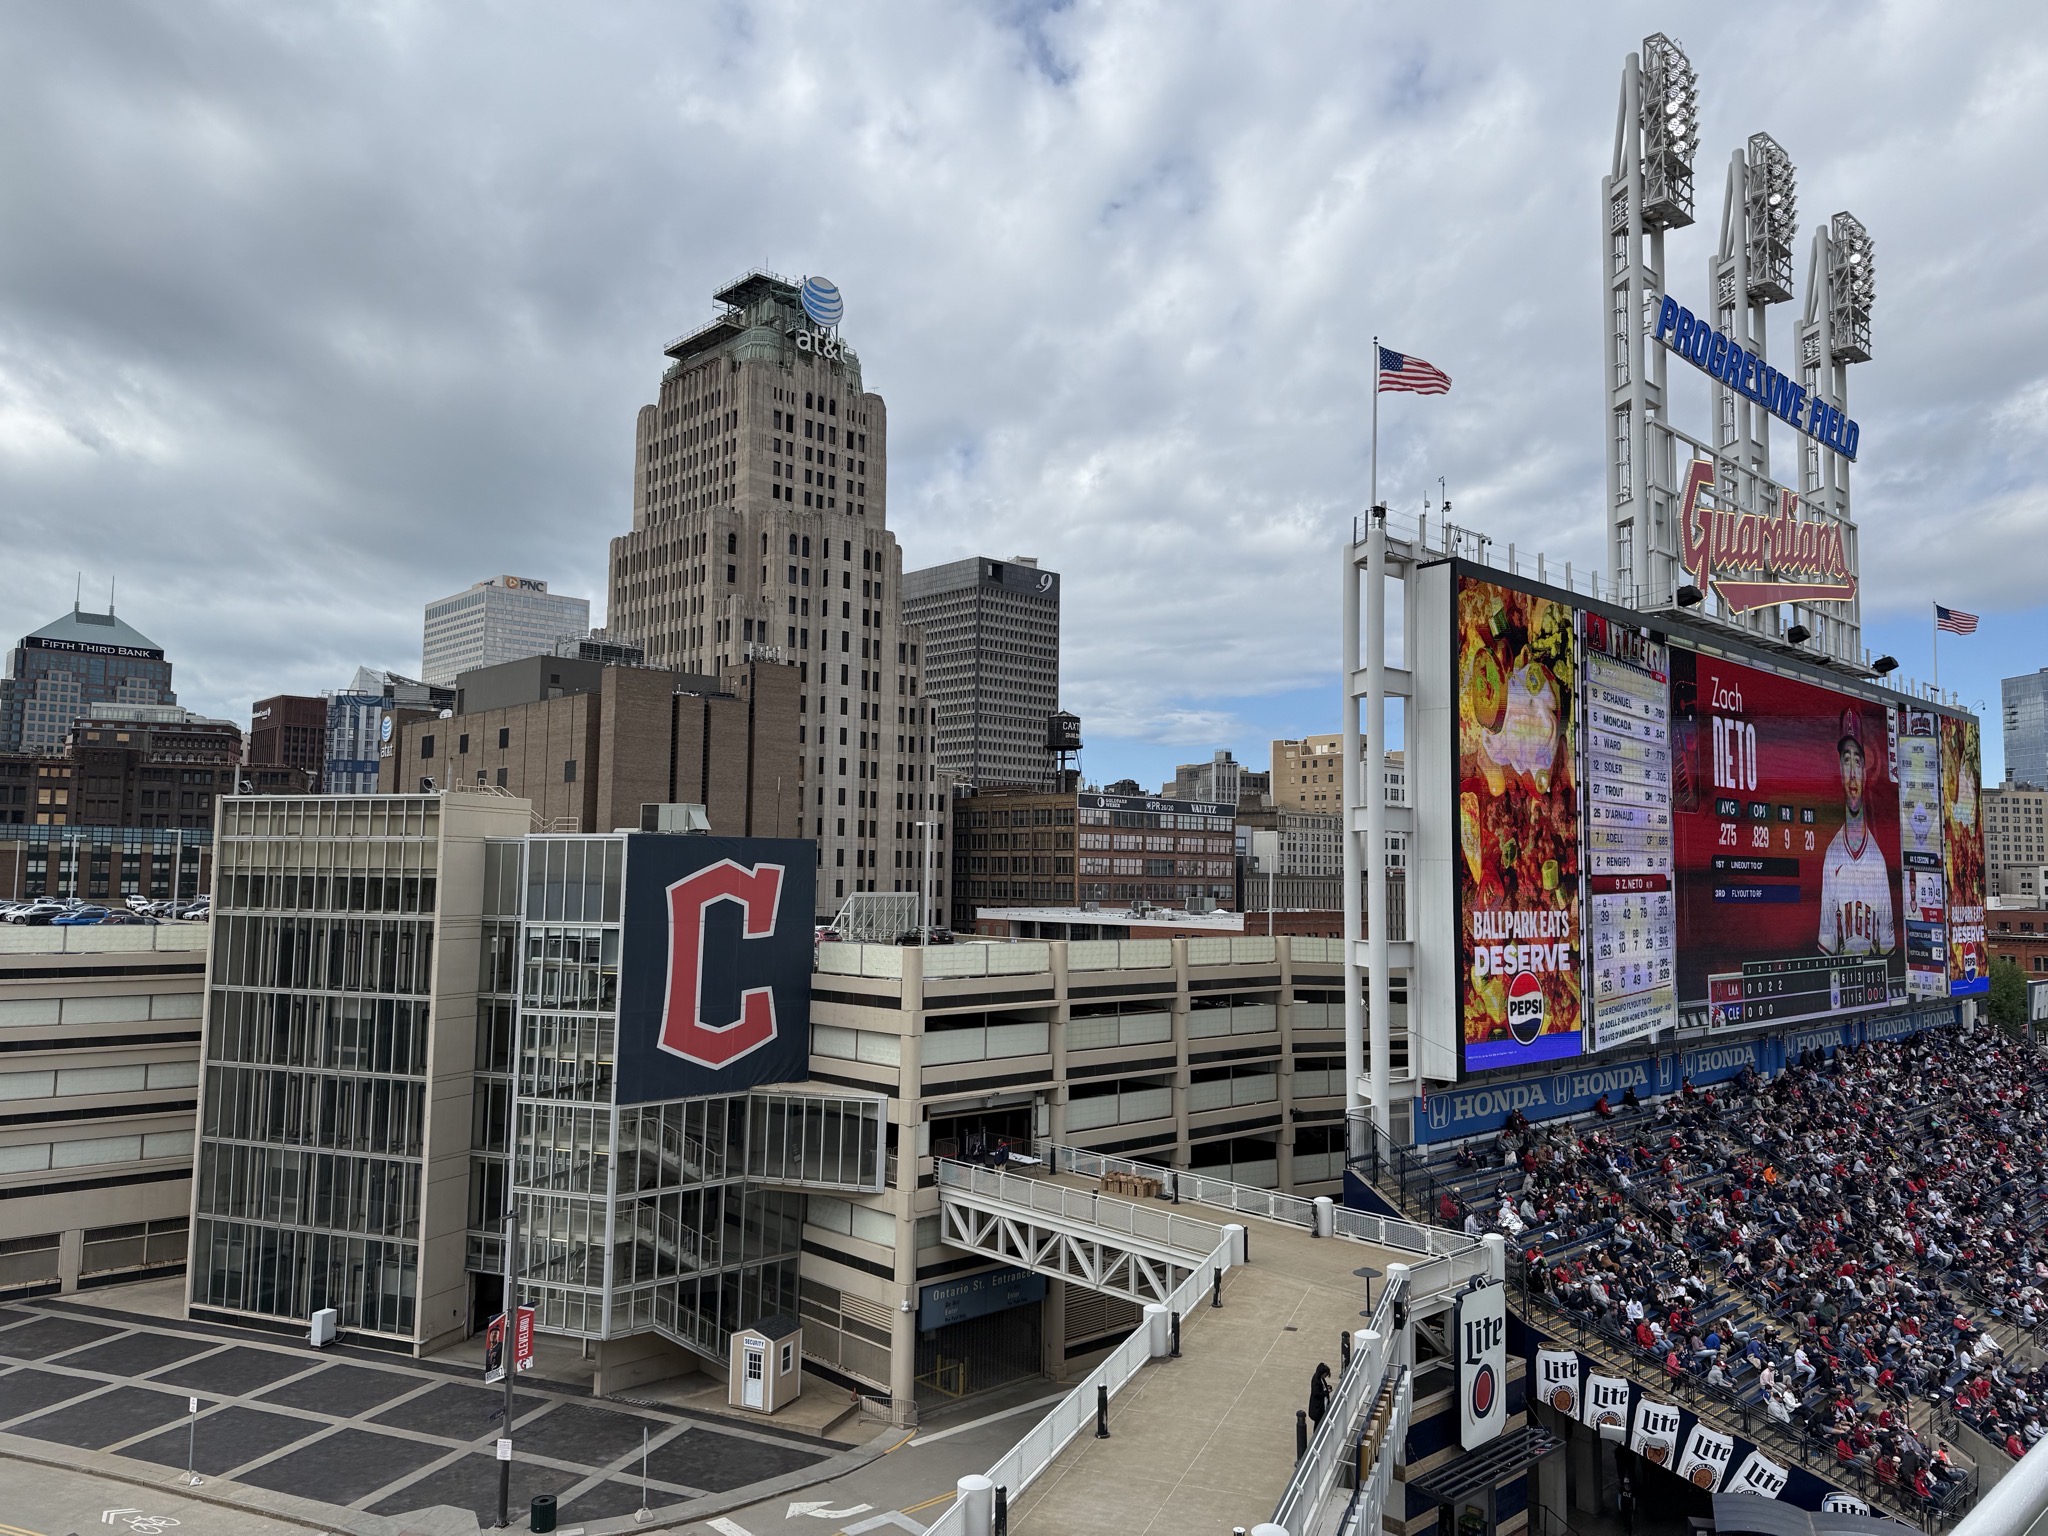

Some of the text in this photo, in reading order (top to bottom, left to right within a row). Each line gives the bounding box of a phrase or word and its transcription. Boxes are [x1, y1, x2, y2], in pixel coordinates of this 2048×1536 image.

[796, 328, 849, 364] at&t
[1656, 294, 1860, 461] PROGRESSIVE FIELD
[1678, 459, 1850, 608] Guardians
[519, 579, 544, 592] PNC
[1040, 573, 1053, 593] 9
[41, 639, 151, 658] FIFTH THIRD BANK
[1603, 691, 1632, 709] SCHANUEL
[1711, 676, 1743, 713] Zach
[1593, 712, 1598, 722] 5
[1603, 714, 1632, 731] MONCADA
[1593, 736, 1598, 746] 3
[1603, 738, 1621, 750] WARD
[1712, 715, 1757, 791] NETO
[1593, 760, 1599, 770] 12
[1604, 762, 1623, 774] SOLER
[1593, 784, 1600, 794] 27
[1605, 785, 1623, 797] TROUT
[1645, 792, 1652, 801] DH
[1151, 802, 1161, 811] PR
[1594, 808, 1652, 823] 25 D'ARNAUD C
[1721, 801, 1814, 823] AVG OPS HR RBI
[1596, 832, 1600, 842] 7
[1606, 833, 1624, 843] ADELL
[1646, 836, 1653, 845] CF
[1719, 823, 1815, 851] .275 .829 9 20
[1596, 857, 1600, 867] 2
[1606, 857, 1631, 867] RENGIFO
[1731, 861, 1751, 869] LINEOUT
[1615, 879, 1620, 890] 9
[1622, 879, 1643, 889] Z.NETO
[1715, 890, 1726, 898] 3RD
[1731, 889, 1749, 898] FLYOUT
[1603, 899, 1607, 908] G
[1601, 906, 1668, 922] 39 42 79 .313
[1951, 906, 1973, 923] BALLPARK
[1974, 906, 1984, 921] EATS
[1473, 910, 1570, 940] BALLPARK EATS
[1952, 926, 1985, 943] DESERVE
[1600, 944, 1611, 957] 163
[1619, 943, 1626, 953] 10
[1634, 941, 1638, 951] 7
[1646, 939, 1653, 949] 29
[656, 857, 786, 1071] C
[1474, 943, 1571, 976] DESERVE
[1601, 968, 1670, 993] 153 0 49 8 .829
[1728, 984, 1739, 996] LAA
[1747, 983, 1752, 994] 0
[1757, 982, 1763, 993] 0
[1768, 981, 1773, 992] 2
[1778, 980, 1783, 991] 2
[1842, 974, 1845, 983] 6
[1858, 972, 1861, 982] 3
[1510, 999, 1542, 1016] PEPSI
[1609, 1003, 1626, 1015] RENGIFO
[1626, 1000, 1641, 1010] FLYOUT
[1728, 1005, 1740, 1021] CLE
[1748, 1006, 1753, 1018] 0
[1758, 1005, 1763, 1016] 0
[1769, 1004, 1774, 1015] 0
[1858, 993, 1862, 1002] 5
[1605, 1019, 1617, 1029] ADELL
[1875, 1017, 1912, 1038] HONDA
[1923, 1010, 1956, 1028] HONDA
[1599, 1033, 1615, 1044] TRAVIS
[1797, 1029, 1844, 1051] HONDA
[1698, 1045, 1756, 1073] HONDA
[1573, 1065, 1648, 1097] HONDA
[1453, 1083, 1548, 1121] HONDA
[933, 1270, 1031, 1301] Ontario St. Entrance
[945, 1307, 959, 1316] Enter
[745, 1338, 764, 1347] SECURITY
[1465, 1316, 1503, 1365] Lite
[1543, 1359, 1577, 1384] Lite
[1592, 1383, 1628, 1409] Lite
[1641, 1409, 1678, 1435] Lite
[1692, 1433, 1731, 1461] Lite
[1743, 1460, 1785, 1493] Lite
